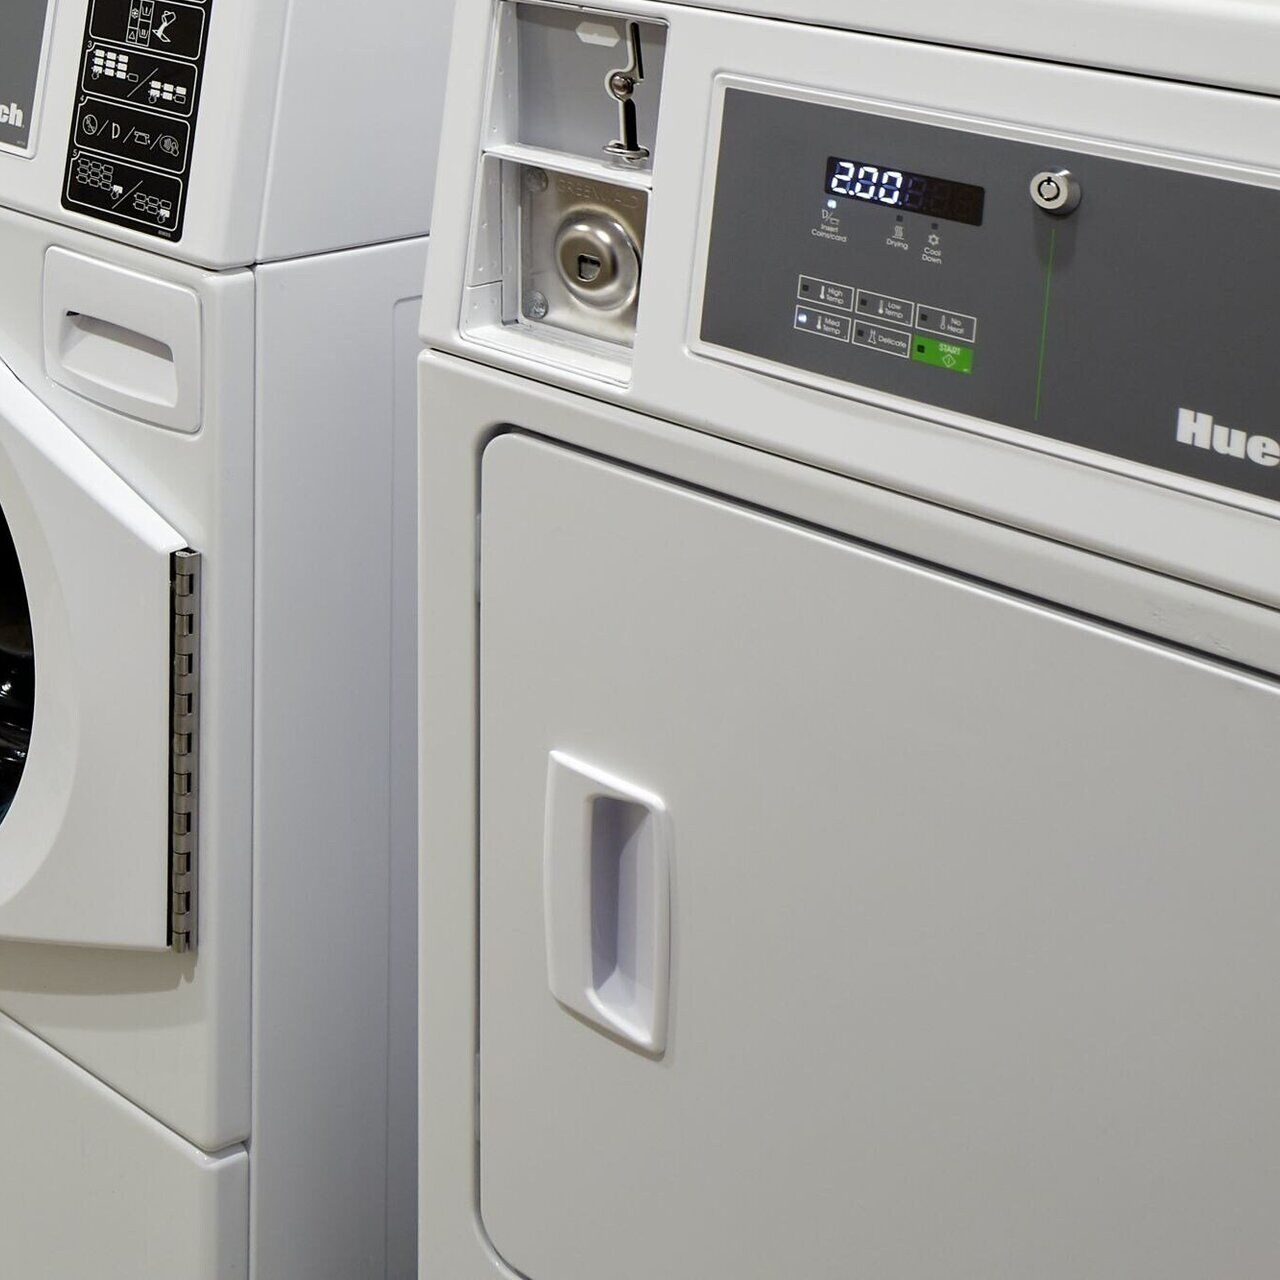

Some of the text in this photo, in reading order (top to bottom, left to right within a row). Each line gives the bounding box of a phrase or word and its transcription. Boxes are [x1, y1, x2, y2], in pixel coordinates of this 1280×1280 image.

[87, 40, 93, 48] 3
[831, 162, 902, 204] 2.00
[887, 238, 908, 250] Drying
[924, 247, 941, 256] Cool
[922, 254, 942, 264] Down
[828, 287, 843, 298] High
[826, 295, 844, 305] Temp
[888, 302, 901, 310] Low
[885, 308, 903, 319] Temp
[825, 318, 840, 327] Med
[951, 318, 962, 326] No
[823, 324, 841, 335] Temp
[947, 324, 964, 334] Heat
[878, 336, 907, 348] Delicate
[939, 343, 961, 355] START
[1176, 408, 1280, 466] Hue
